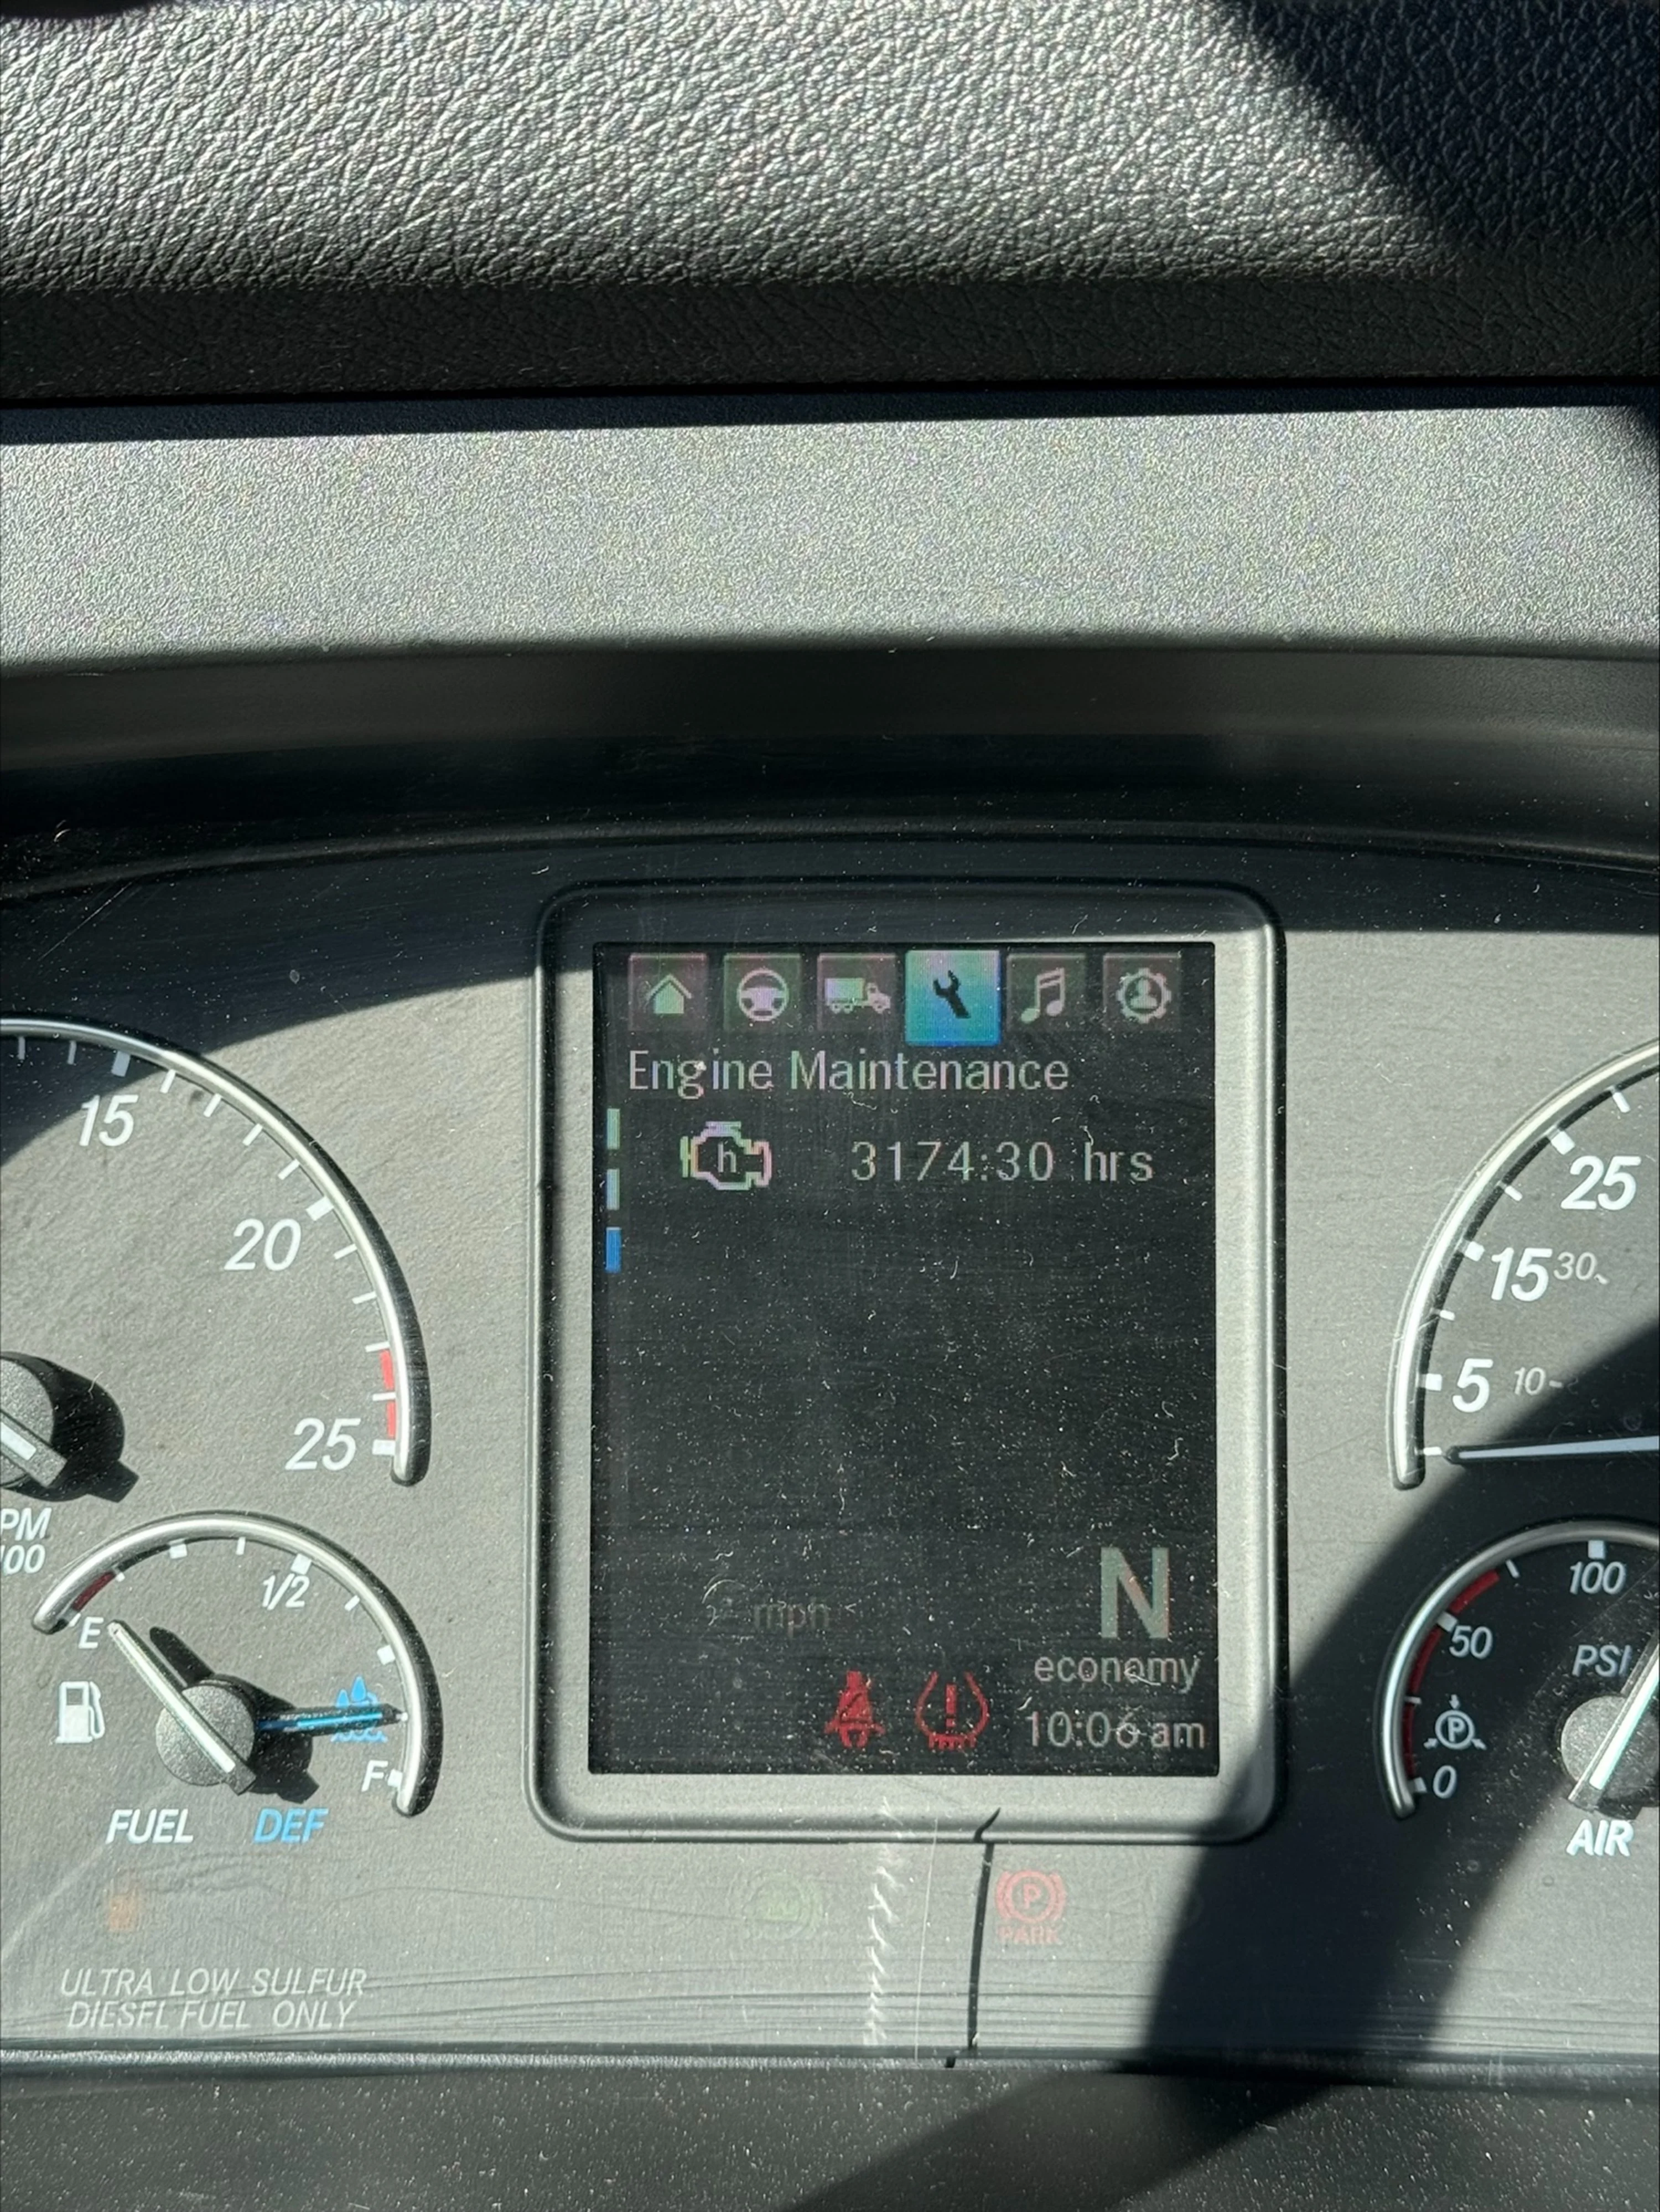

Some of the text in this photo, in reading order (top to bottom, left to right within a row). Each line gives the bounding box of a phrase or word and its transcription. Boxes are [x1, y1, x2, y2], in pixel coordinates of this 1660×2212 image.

[629, 1048, 1069, 1100] Engine Maintenance
[79, 1094, 139, 1147] 15
[718, 1142, 737, 1173] h
[850, 1141, 1154, 1182] 3174:30 hrs
[1560, 1154, 1642, 1211] 25
[224, 1219, 303, 1271] 20
[1491, 1247, 1553, 1302] 15
[1553, 1252, 1597, 1281] 30
[1451, 1358, 1493, 1413] 5
[1513, 1367, 1546, 1395] 10
[284, 1417, 362, 1471] 25
[261, 1574, 310, 1610] 1/2
[1099, 1546, 1171, 1640] N
[1569, 1561, 1627, 1595] 100
[79, 1616, 105, 1649] E
[1449, 1625, 1493, 1660] 50
[1034, 1656, 1201, 1695] economy
[1572, 1644, 1633, 1677] PSI
[1026, 1711, 1205, 1749] 10:06 am
[1447, 1716, 1465, 1743] P
[361, 1760, 388, 1793] F
[1432, 1765, 1457, 1799] 0
[105, 1808, 194, 1844] FUEL
[253, 1807, 329, 1843] DEF
[1566, 1819, 1635, 1857] AIR
[1023, 1883, 1041, 1909] P
[998, 1925, 1063, 1945] PARK
[61, 1967, 367, 1997] ULTRA LOW SULFUR
[180, 1999, 251, 2029] FUEL
[273, 1999, 358, 2029] ONLY
